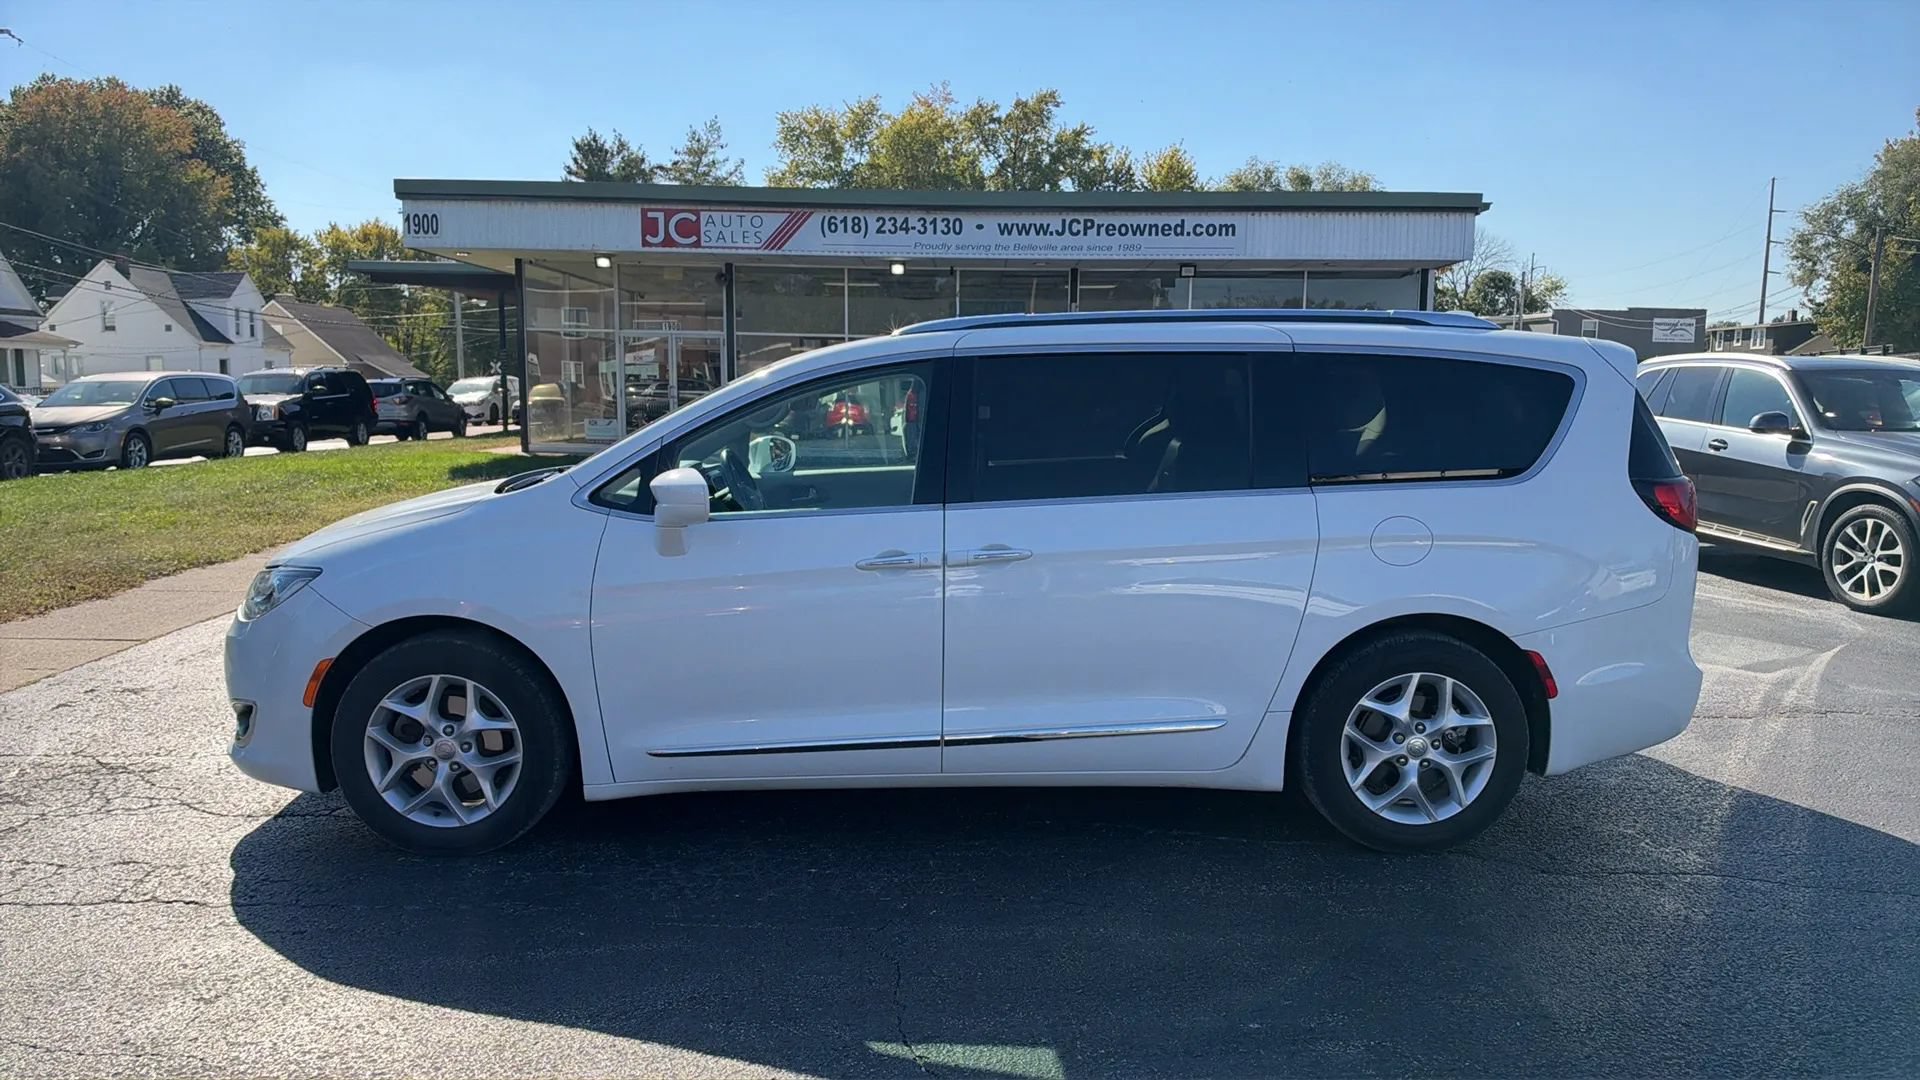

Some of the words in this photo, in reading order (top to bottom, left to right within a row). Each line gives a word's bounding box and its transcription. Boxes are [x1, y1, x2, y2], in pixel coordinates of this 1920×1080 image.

[404, 213, 439, 235] 1900
[645, 211, 698, 245] JC
[704, 214, 764, 229] AUTO
[820, 215, 869, 239] (618)
[875, 216, 963, 236] 234-3130
[997, 217, 1236, 238] www.JCPreowned.com
[703, 230, 763, 244] SALES
[913, 241, 953, 252] Proudly
[955, 243, 992, 253] serving
[994, 242, 1011, 252] the
[1013, 242, 1058, 252] Belleville
[1060, 244, 1083, 252] area
[1086, 243, 1113, 252] since
[1117, 243, 1142, 252] 1989
